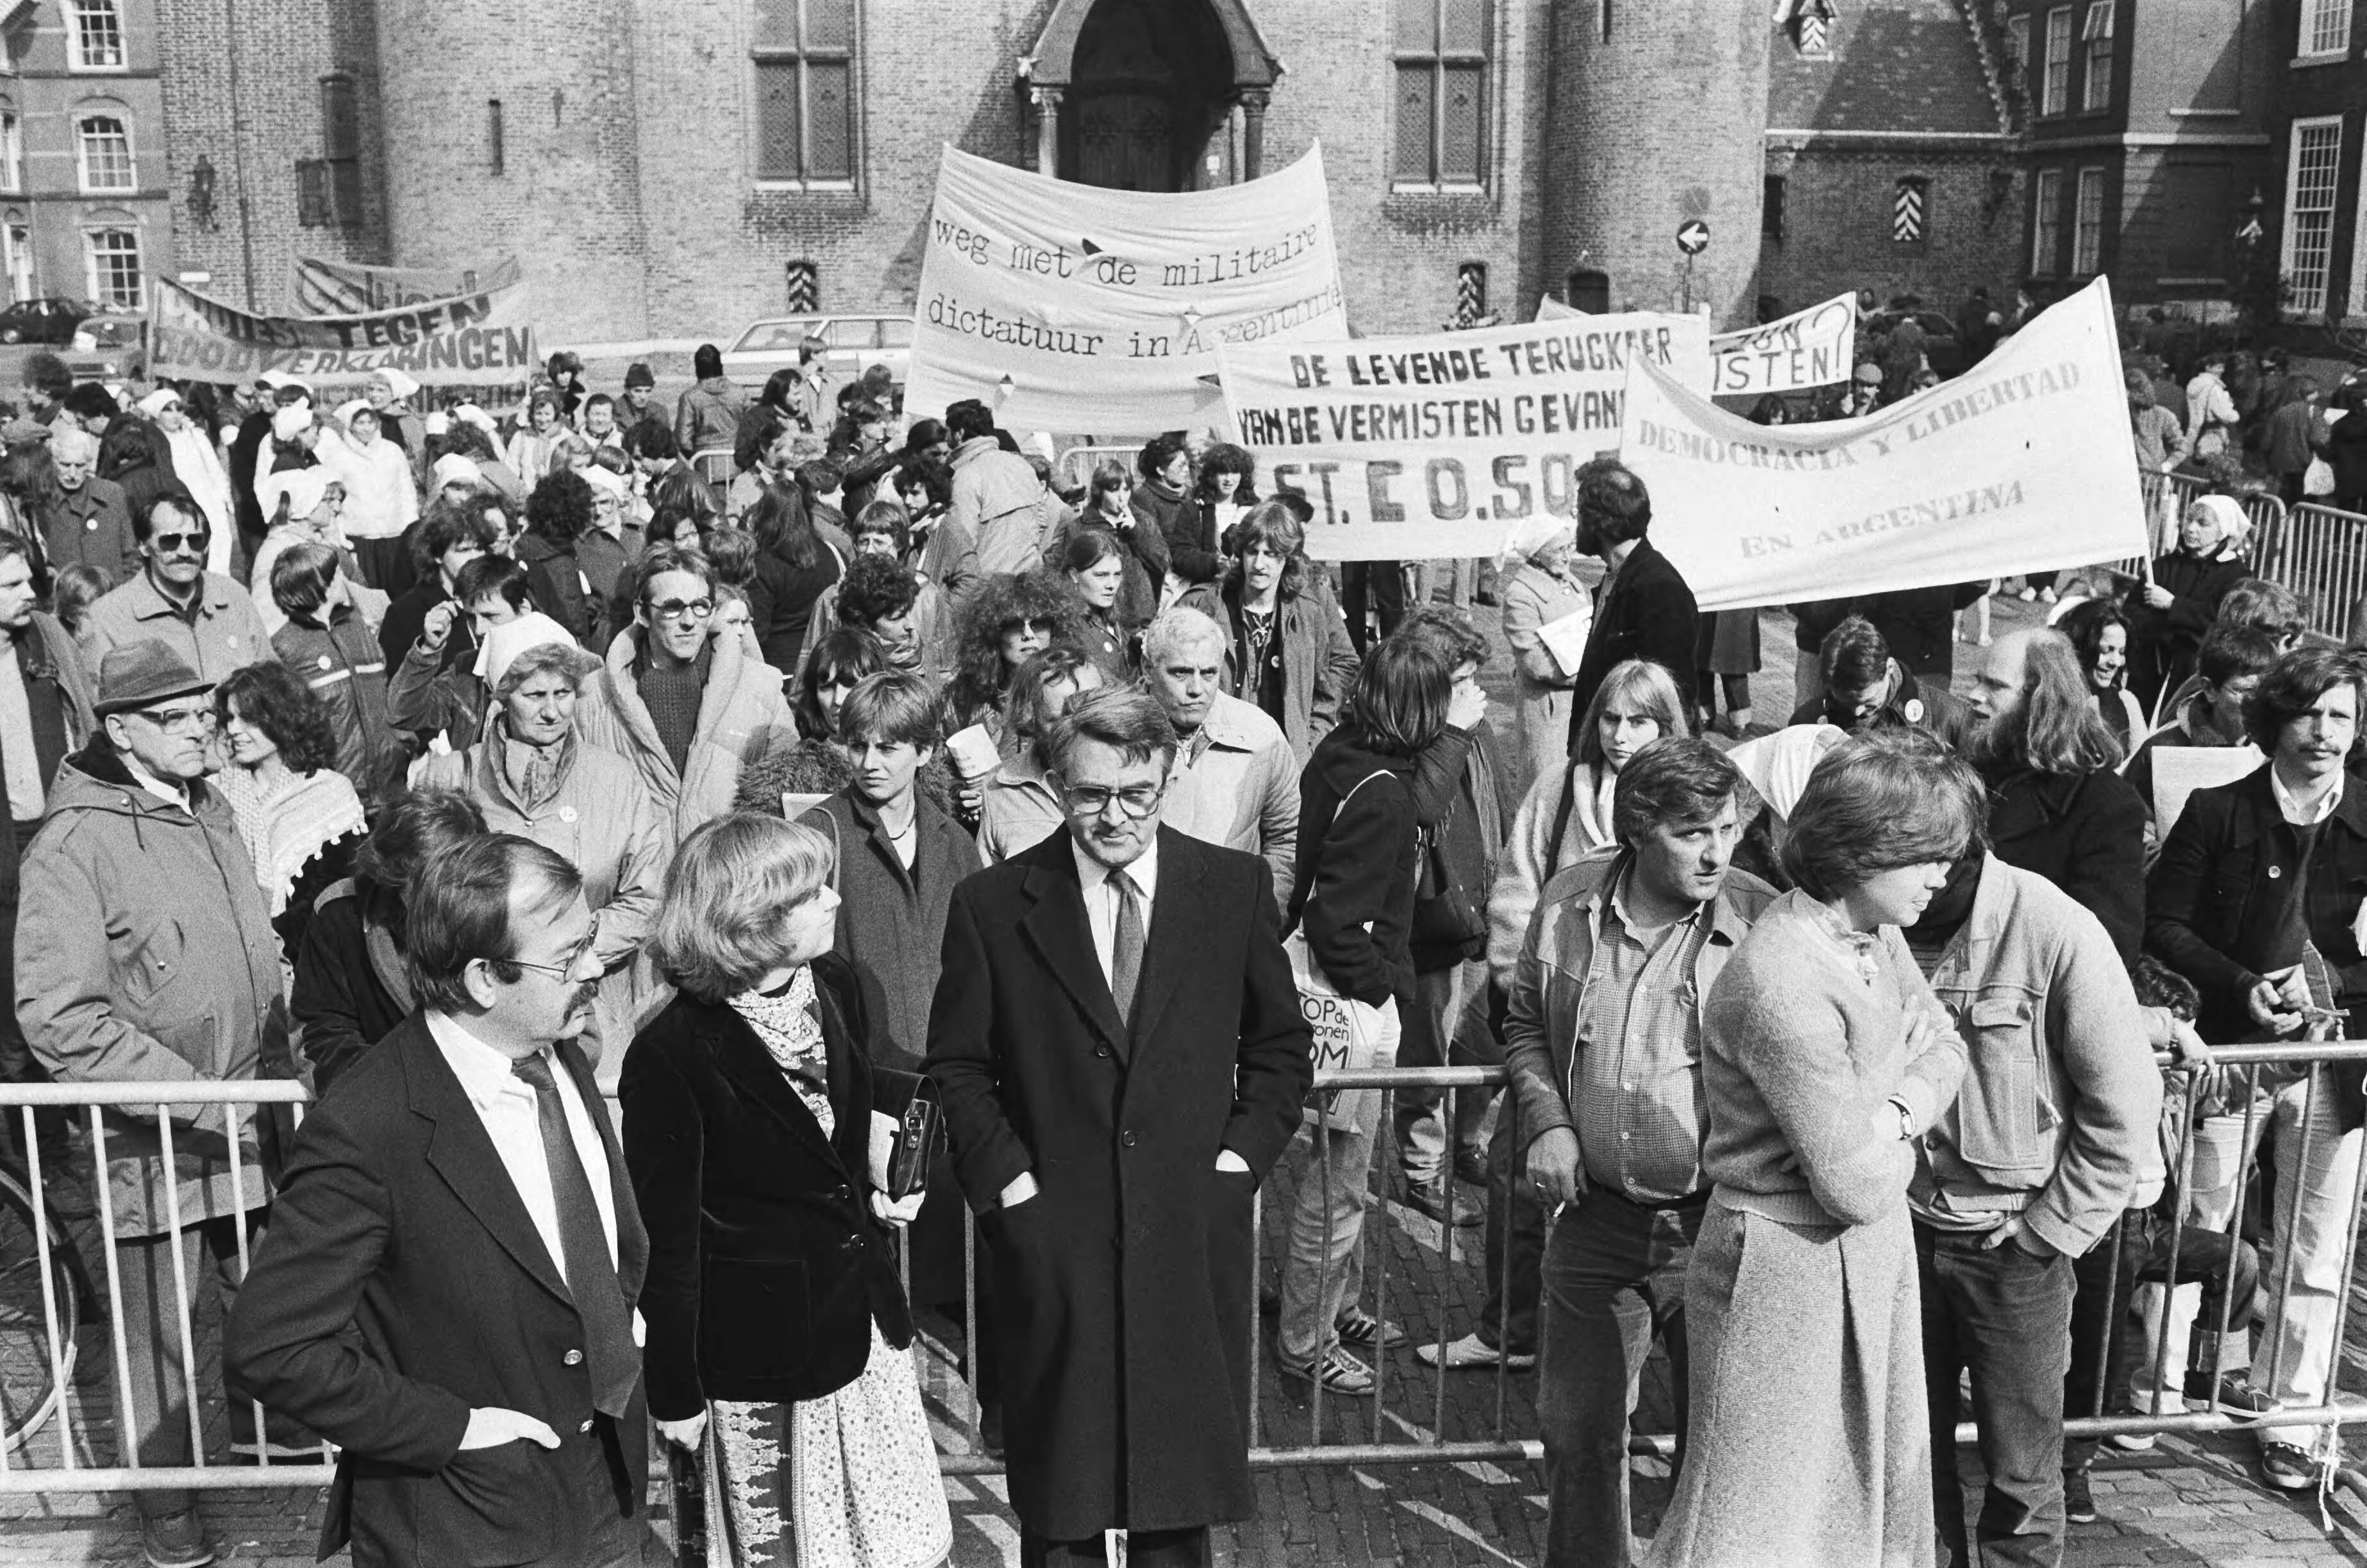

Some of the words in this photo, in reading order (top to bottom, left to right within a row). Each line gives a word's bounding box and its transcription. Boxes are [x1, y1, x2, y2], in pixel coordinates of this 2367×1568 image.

[936, 220, 989, 265] weg
[1010, 246, 1072, 278] met
[1097, 255, 1136, 285] de
[1162, 224, 1316, 286] militaire
[324, 294, 491, 348] TEGEN
[929, 293, 1103, 355] dictatuur
[1128, 331, 1169, 358] in
[1291, 354, 1331, 388] DE
[1346, 348, 1491, 386] LEVENDE
[1328, 396, 1503, 441] VERMISTEN
[1639, 419, 1861, 471] DEMOCRACIA
[1868, 433, 1891, 456] Y
[1906, 360, 2080, 444] LIBERTAD
[1740, 535, 1794, 559] EN
[1814, 480, 2025, 545] ARGENTINA
[1335, 1008, 1349, 1026] de
